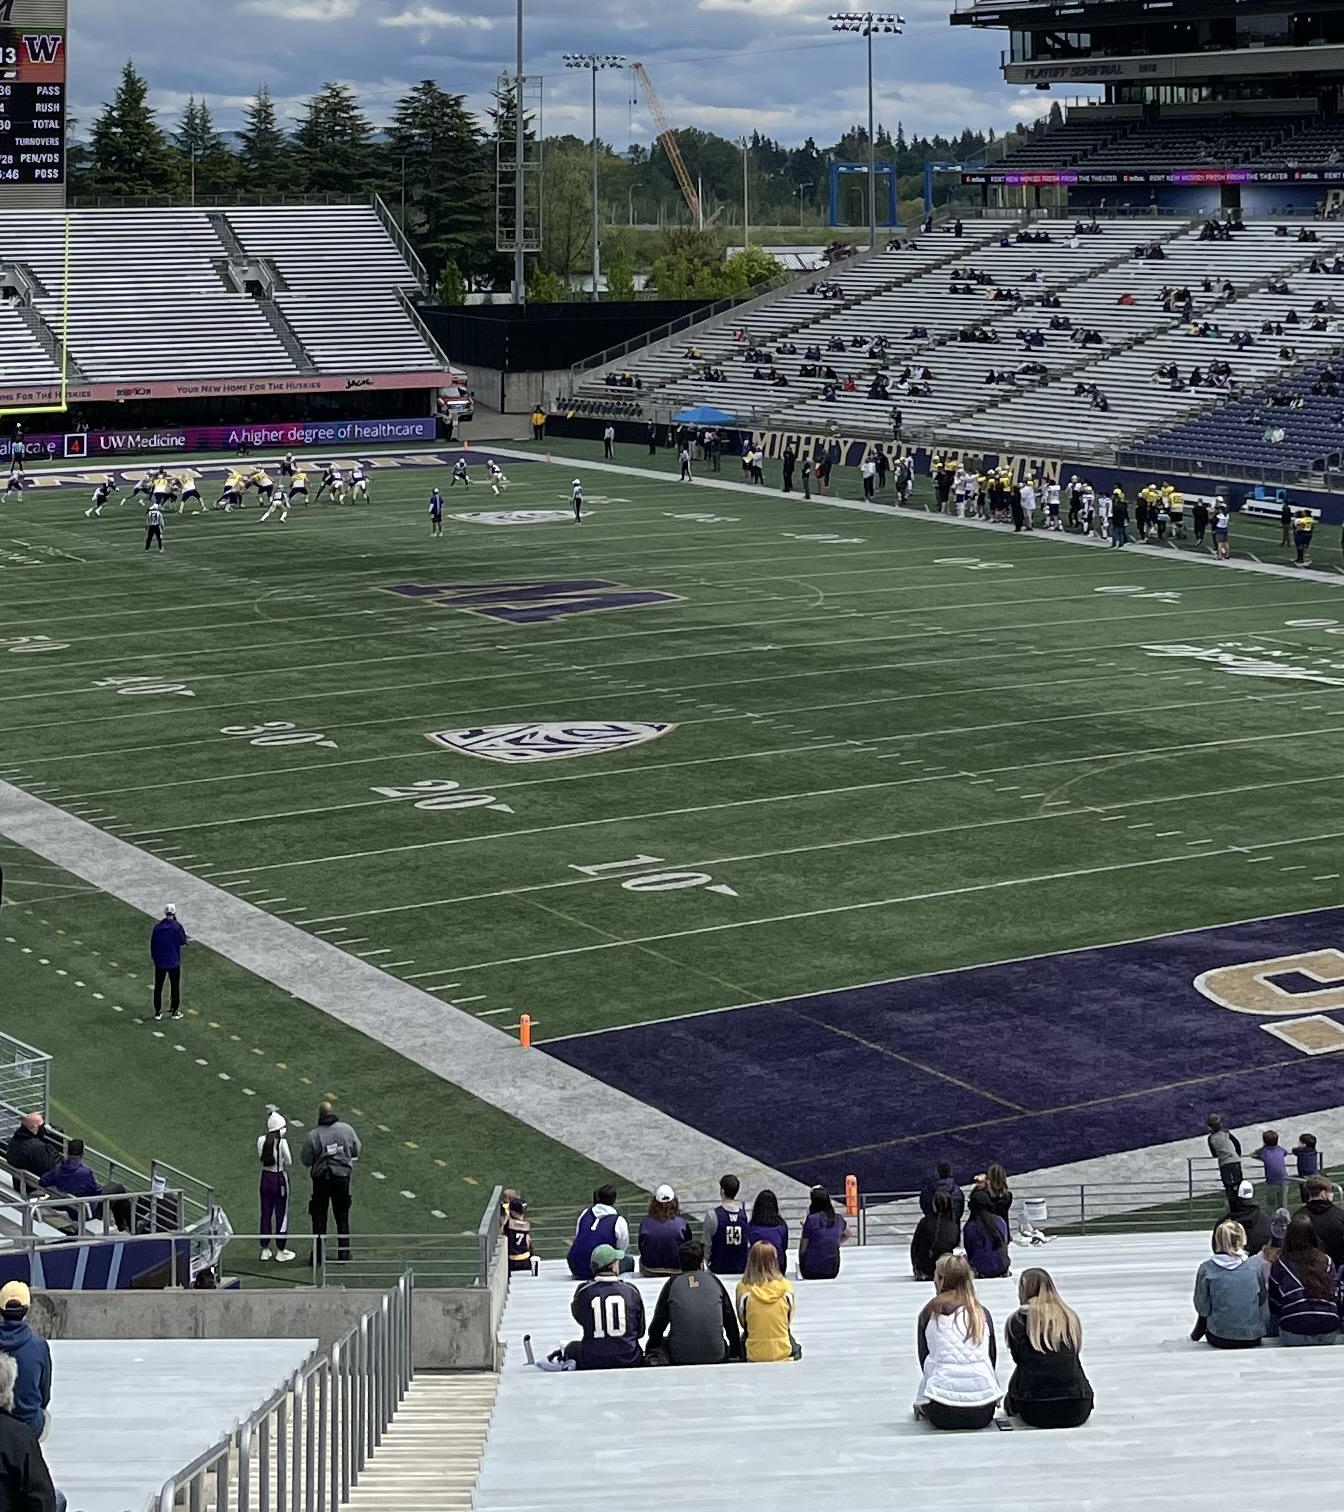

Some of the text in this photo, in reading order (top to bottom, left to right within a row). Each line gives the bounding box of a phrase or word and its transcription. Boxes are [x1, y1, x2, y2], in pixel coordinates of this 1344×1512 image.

[23, 34, 62, 64] W
[36, 86, 61, 96] PASS
[35, 102, 60, 113] RUSH
[32, 119, 60, 129] TOTAL
[15, 137, 60, 147] TURNOVERS
[20, 153, 60, 164] PEN/YDS
[35, 169, 59, 179] POSS
[100, 433, 185, 450] UW Medicine
[229, 421, 424, 447] A higher degree of healthcare
[69, 440, 80, 453] 4
[220, 720, 325, 747] 30
[370, 779, 497, 811] 20
[568, 853, 713, 892] 10
[590, 1294, 626, 1338] 10
